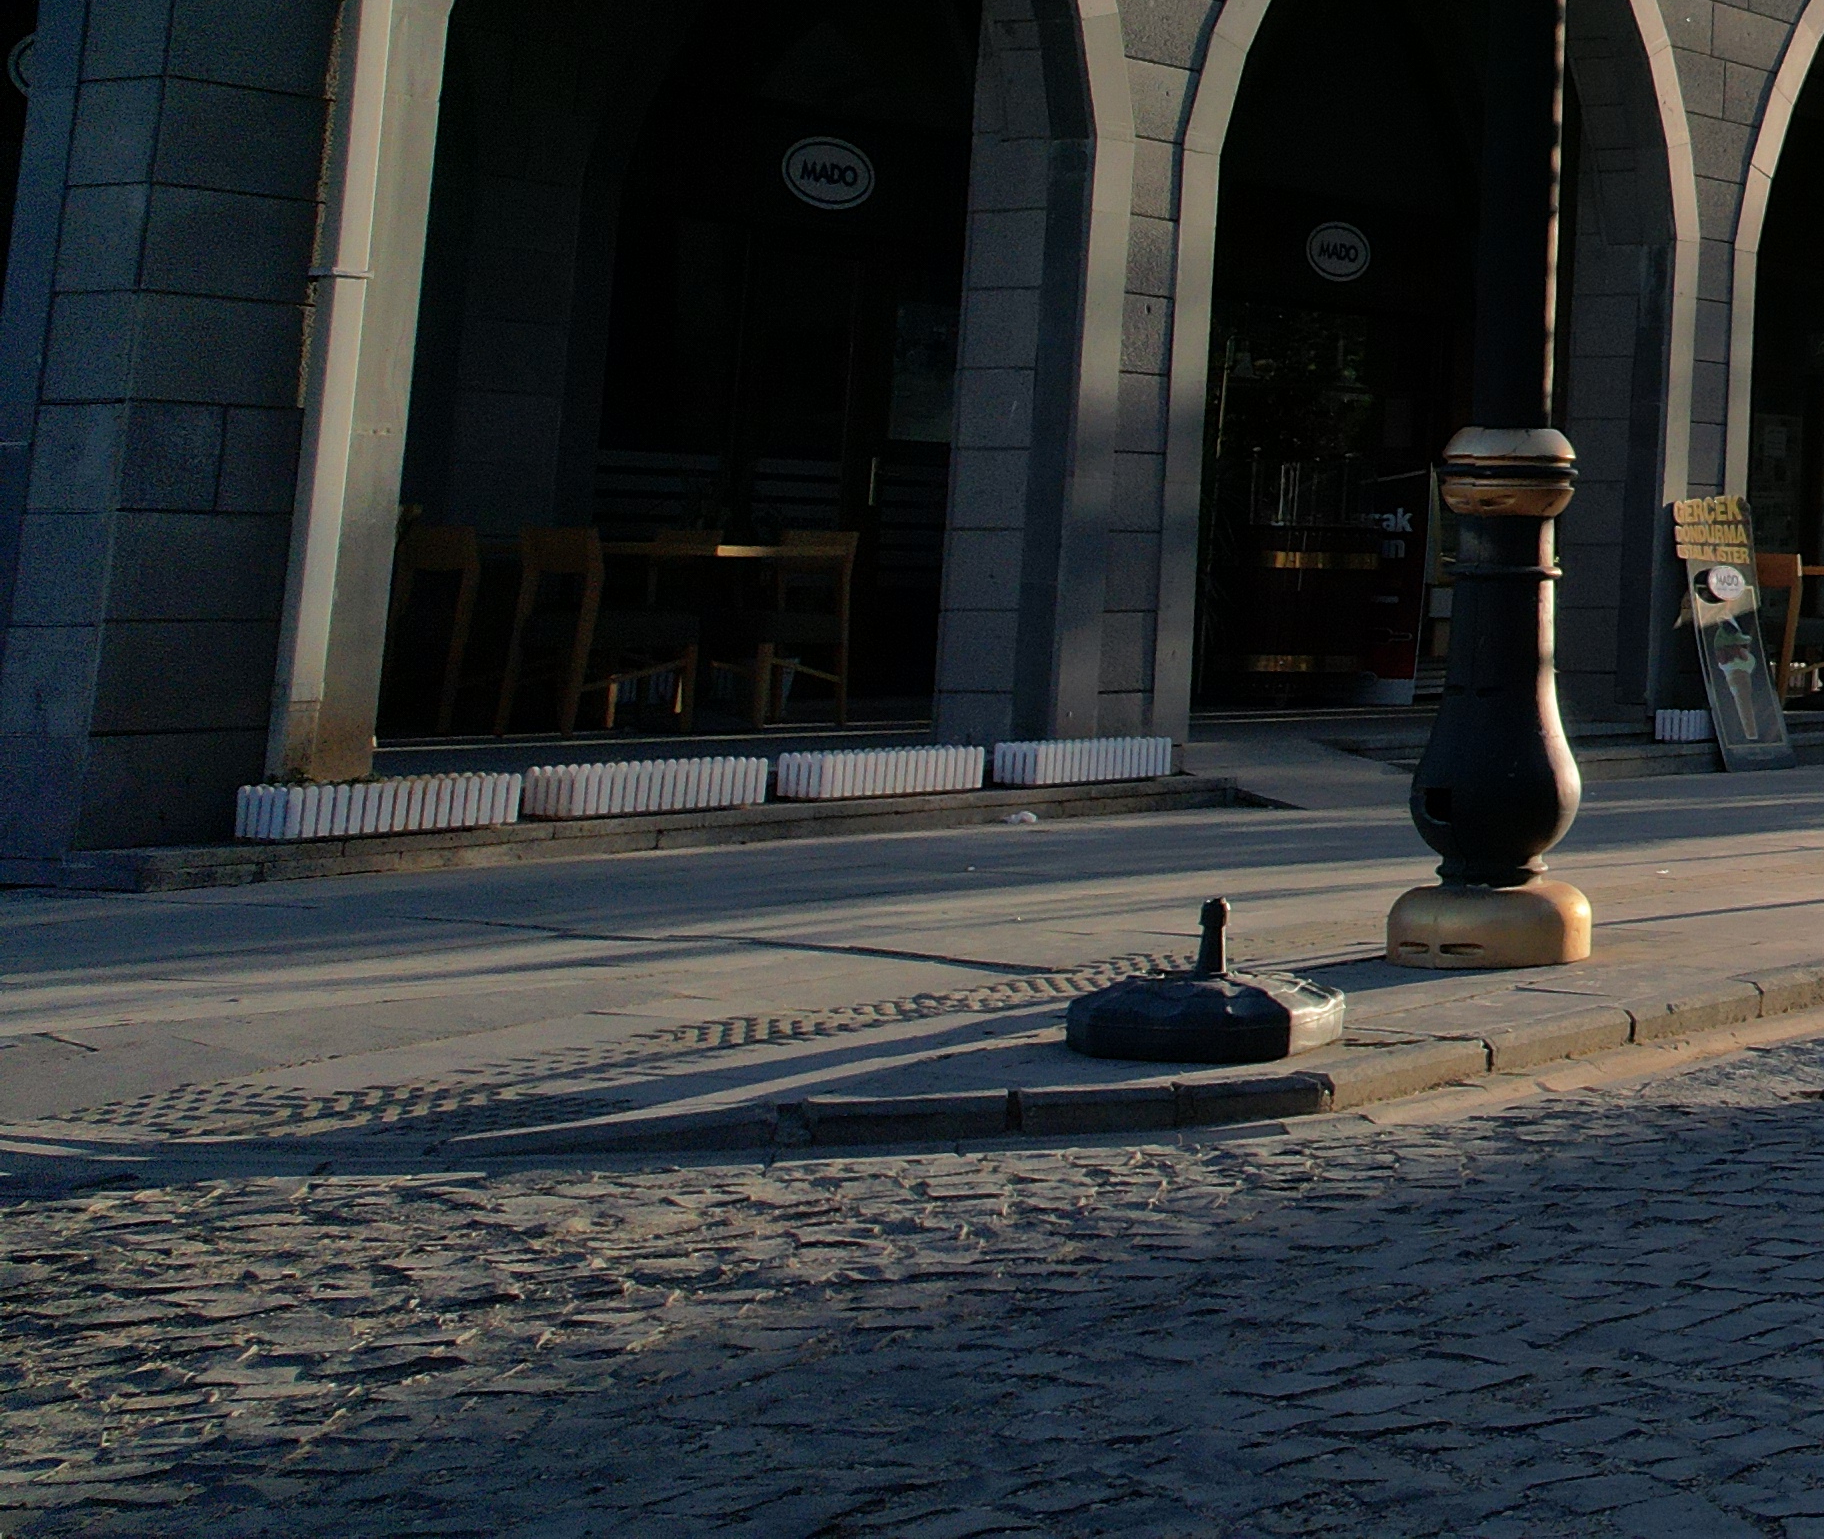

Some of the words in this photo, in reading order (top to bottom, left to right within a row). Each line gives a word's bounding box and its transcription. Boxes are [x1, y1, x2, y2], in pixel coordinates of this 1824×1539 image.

[799, 158, 858, 187] MADO
[1318, 240, 1359, 263] MADO
[1674, 496, 1742, 523] GERÇEK
